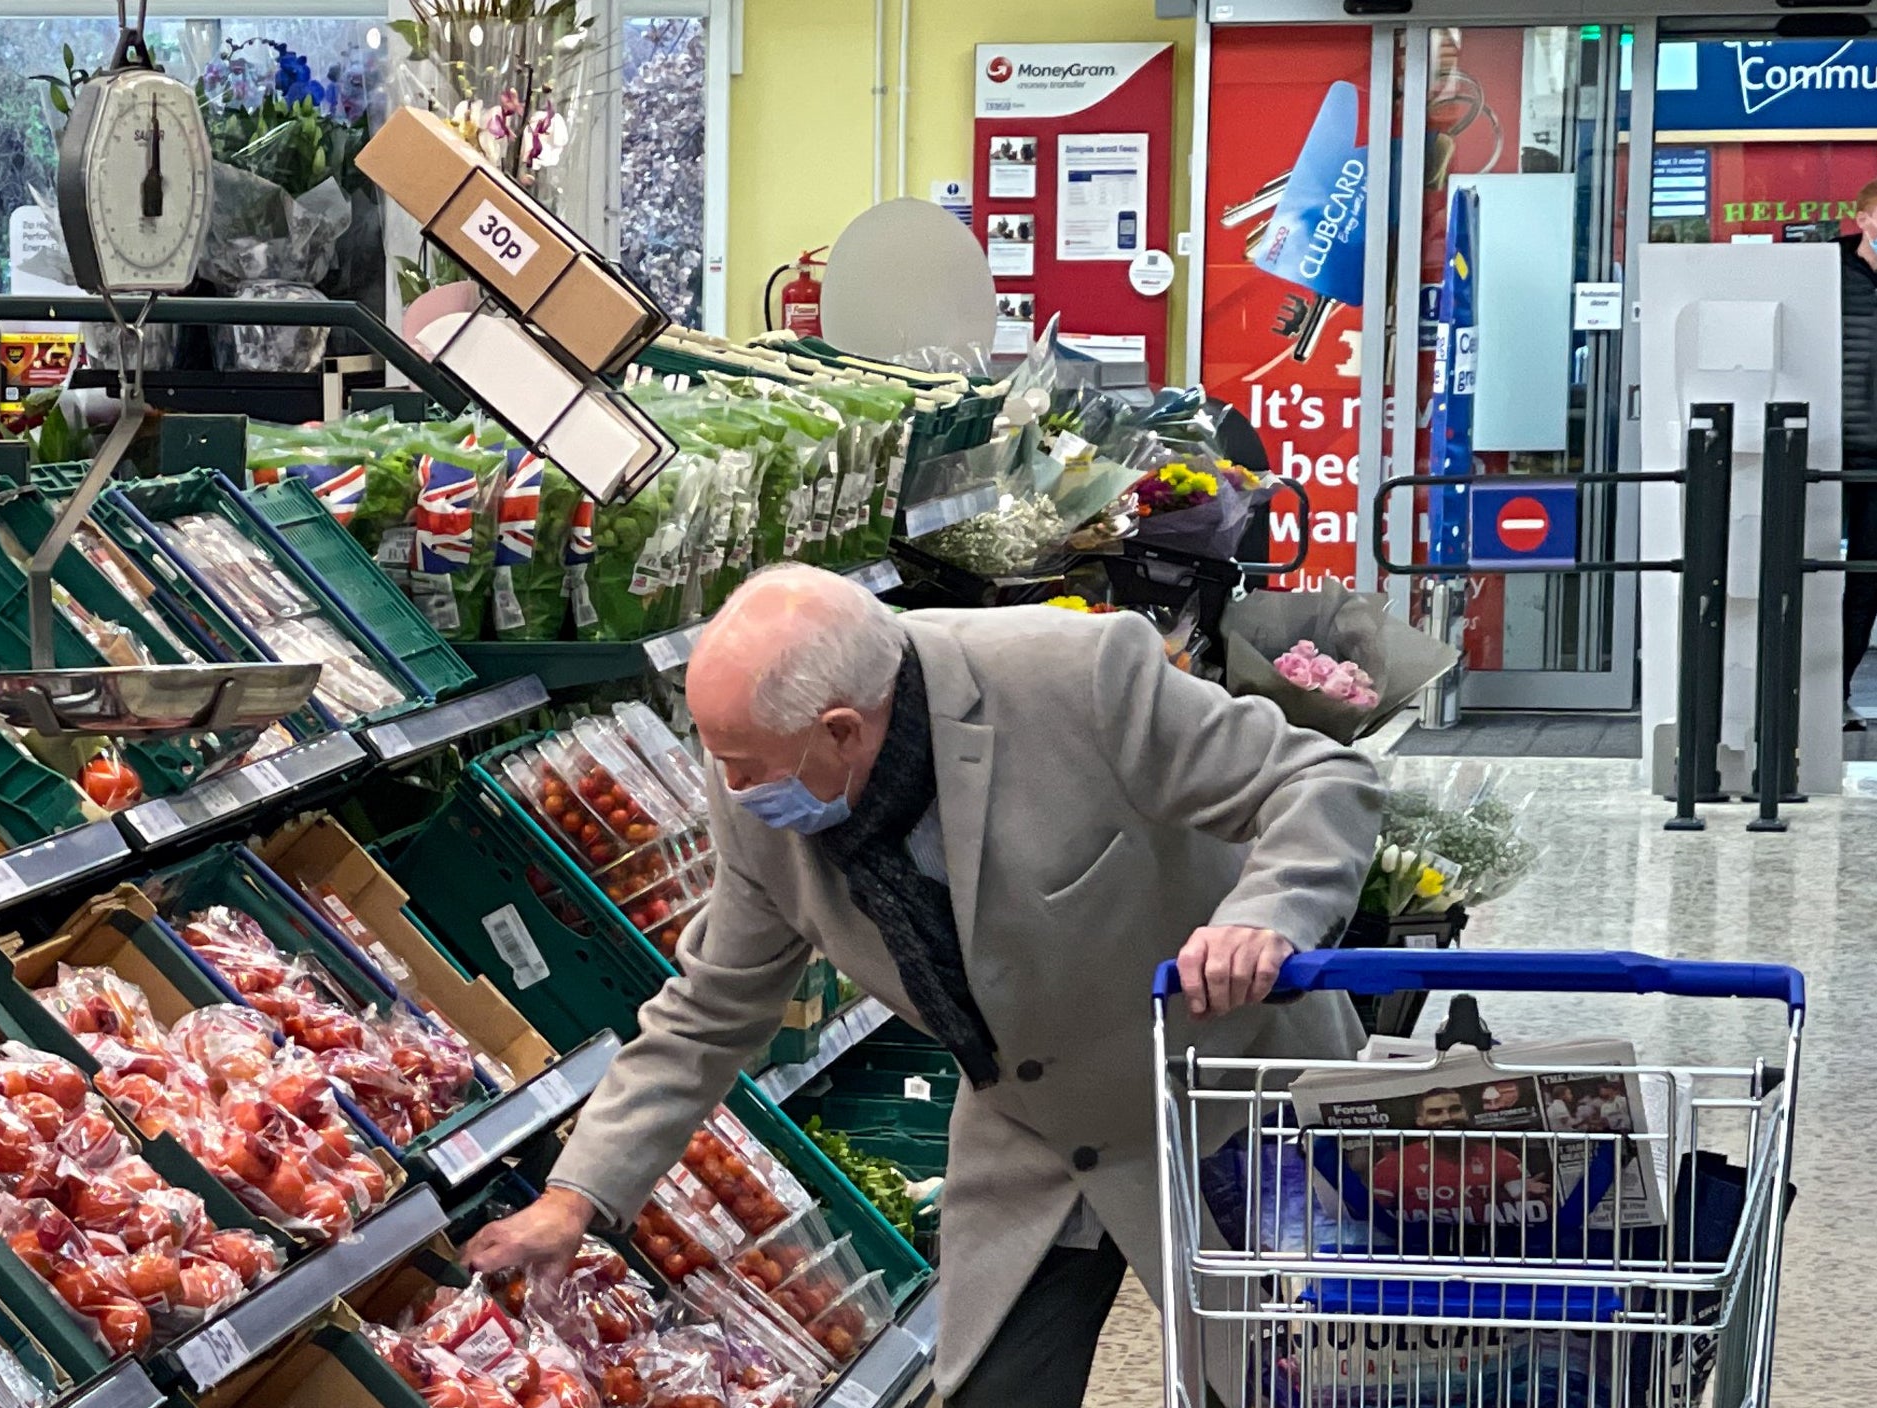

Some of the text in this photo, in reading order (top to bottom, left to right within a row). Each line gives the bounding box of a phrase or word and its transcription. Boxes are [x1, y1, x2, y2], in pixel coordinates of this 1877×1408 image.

[1018, 63, 1116, 80] MoneyGram
[1299, 159, 1365, 279] CLUBCARD
[479, 215, 522, 259] 30p
[1589, 299, 1610, 307] door
[1251, 384, 1324, 429] It's
[1332, 1104, 1378, 1116] Forest
[1353, 1115, 1368, 1125] to
[1369, 1113, 1390, 1124] KO
